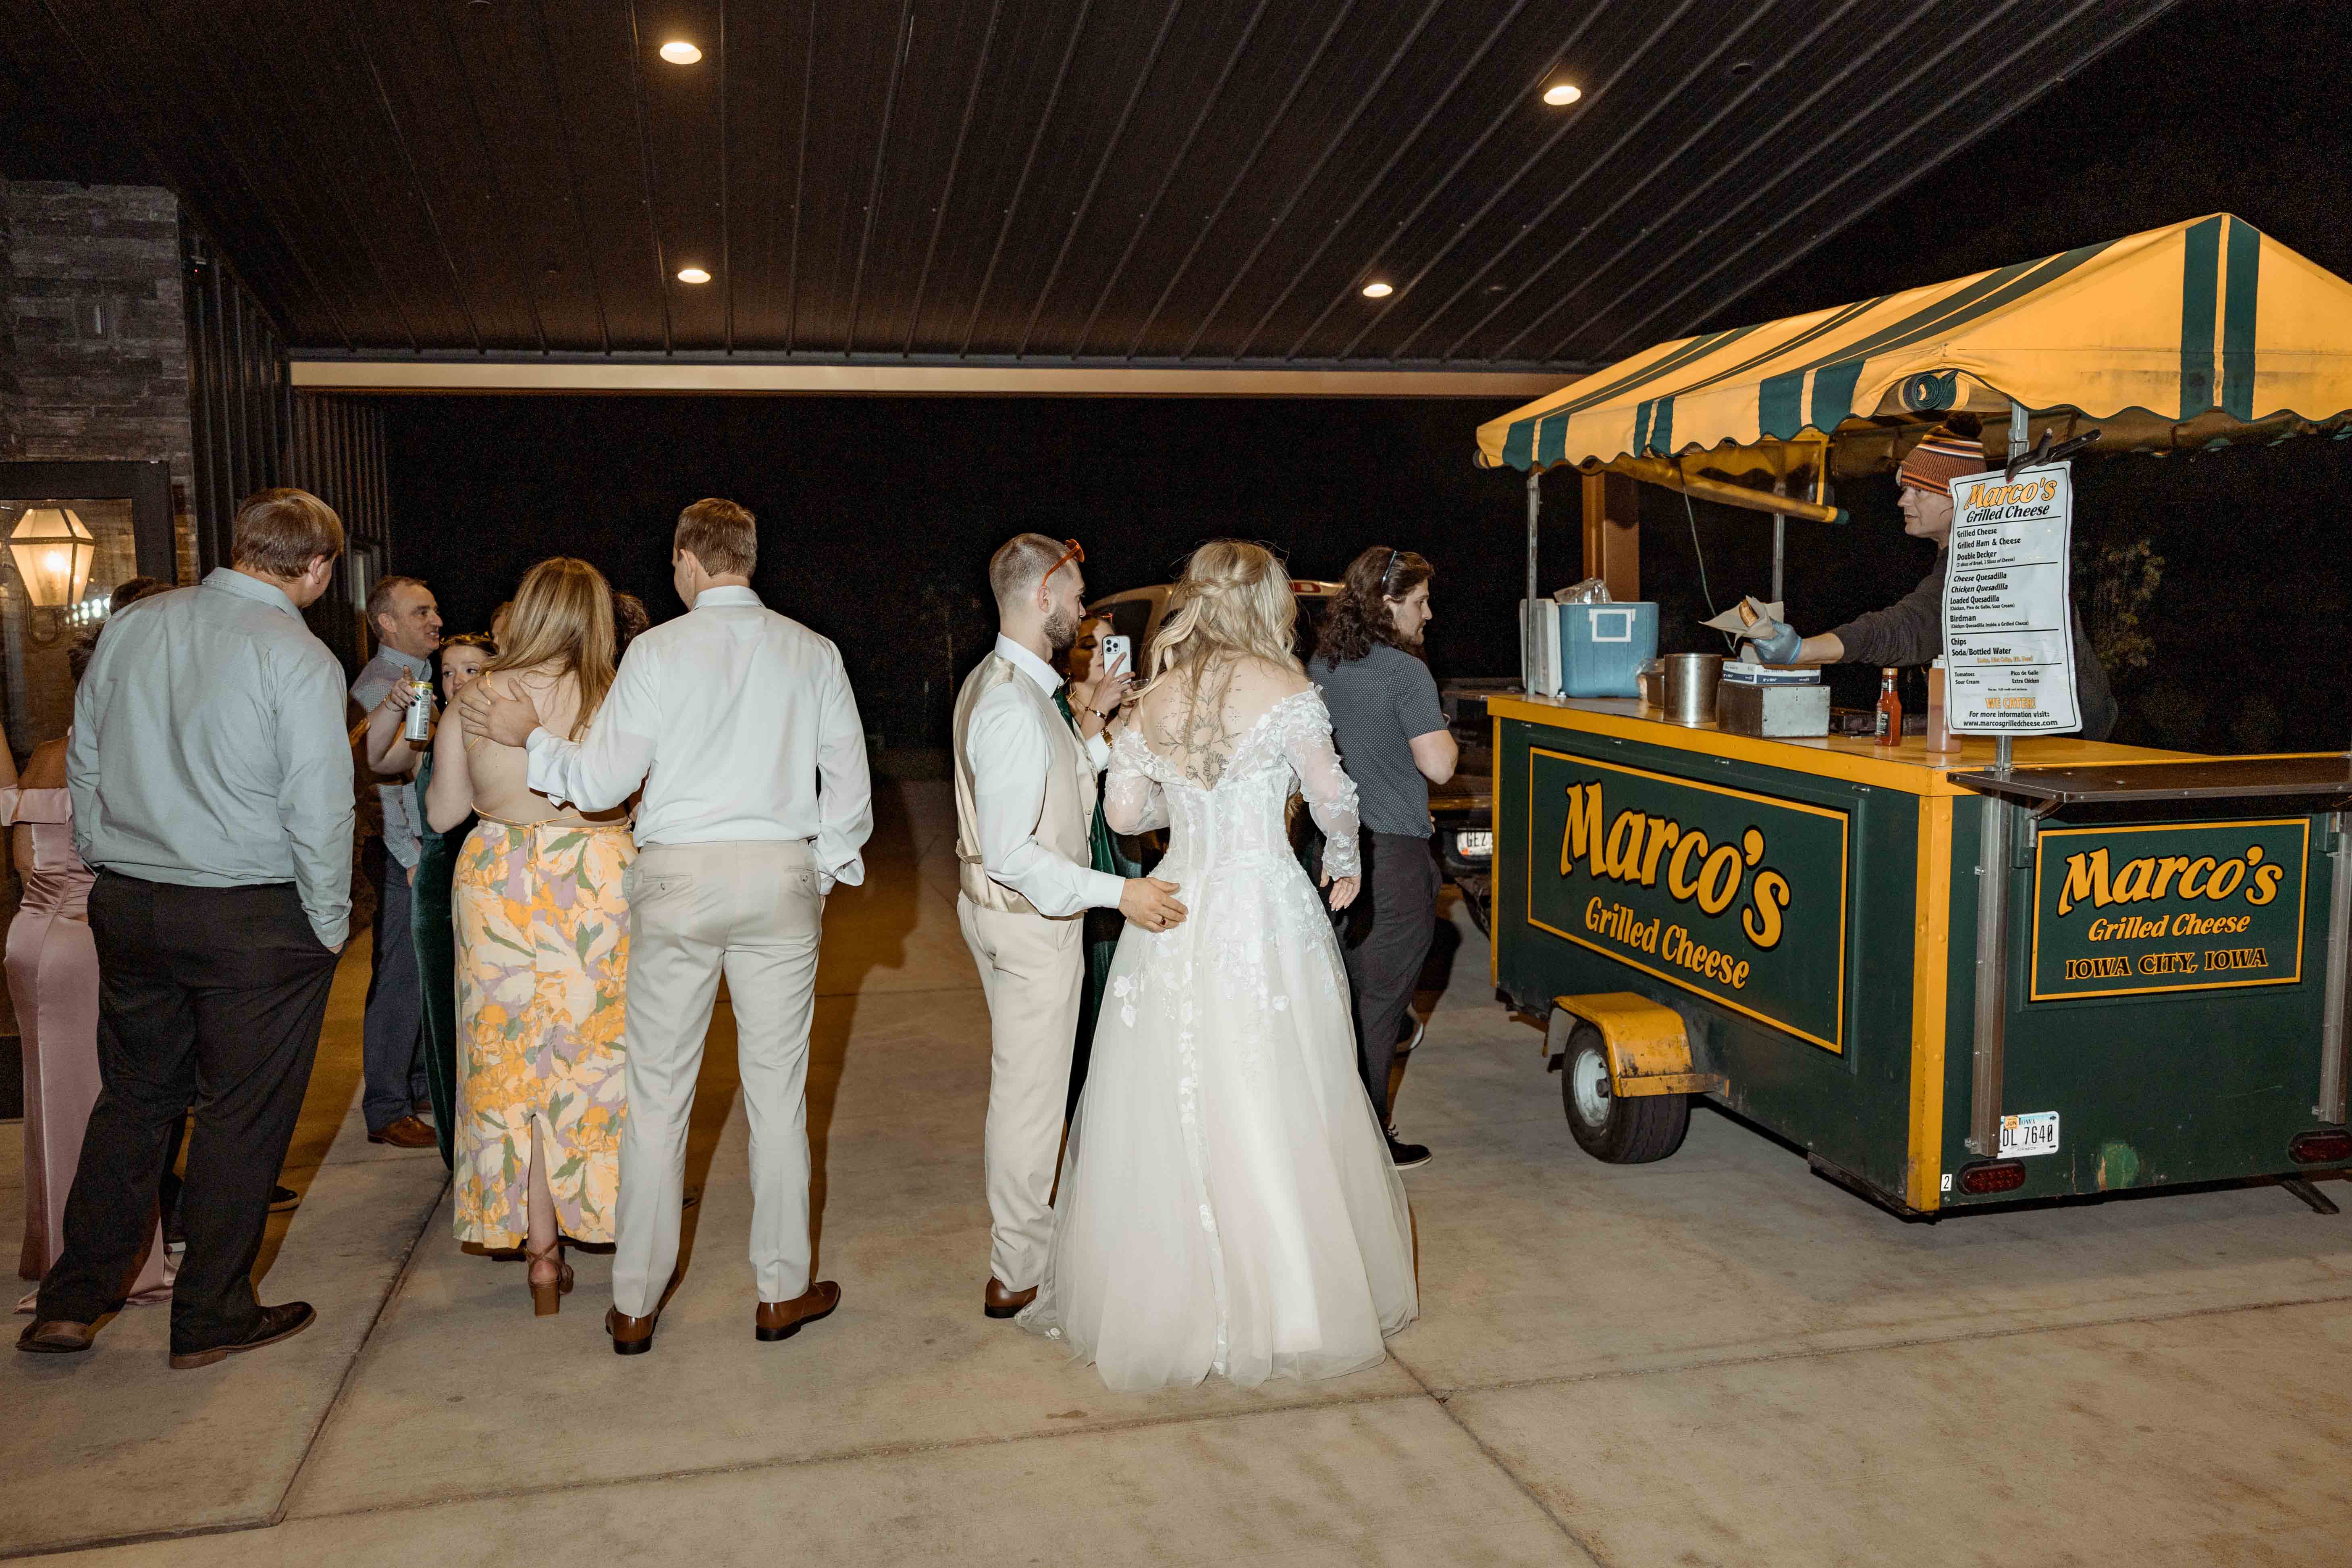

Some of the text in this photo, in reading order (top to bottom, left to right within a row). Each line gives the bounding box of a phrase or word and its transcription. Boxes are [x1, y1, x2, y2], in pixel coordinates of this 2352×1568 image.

[1963, 477, 2057, 510] Marco's
[1967, 505, 2050, 523] Grilled Cheese
[1957, 530, 1975, 538] Grilled
[1957, 541, 1974, 549] Grilled
[1957, 550, 1997, 561] Double Decker
[1976, 571, 2007, 582] Quesadilla
[1976, 583, 2008, 593] Quesadilla
[1970, 595, 1999, 604] Quesadilla
[1951, 638, 1967, 646] Chips
[1952, 648, 1991, 656] Soda/Bottled
[1986, 697, 2036, 709] WE CATER!
[1963, 720, 2058, 728] www.marcosgrilledcheese.com
[1560, 779, 1792, 952] Marco's
[2056, 844, 2284, 917] Marco's
[2088, 913, 2251, 942] Grilled Cheese
[1585, 896, 1750, 990] Grilled Cheese
[2065, 948, 2268, 980] IOWA CITY, IOWA
[2003, 1124, 2053, 1146] DL 7640
[1943, 1175, 1950, 1189] 2
